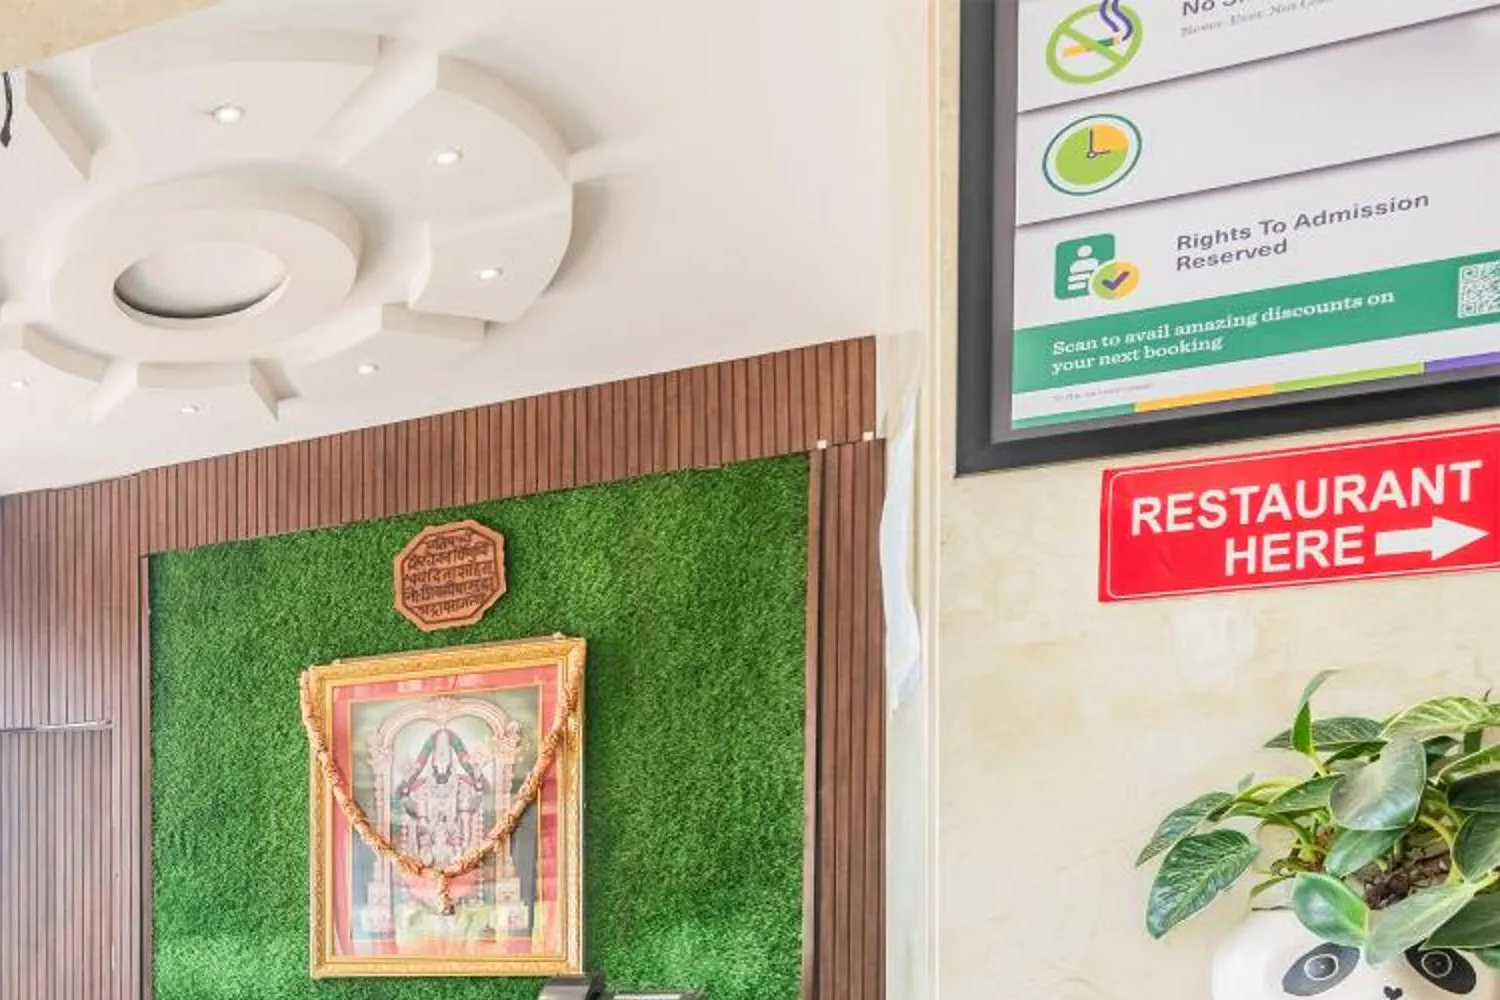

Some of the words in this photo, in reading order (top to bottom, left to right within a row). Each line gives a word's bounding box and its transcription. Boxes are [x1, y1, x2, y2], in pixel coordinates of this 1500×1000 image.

[1177, 227, 1251, 251] Rights
[1258, 219, 1287, 236] To
[1294, 194, 1429, 231] Admission
[1176, 238, 1288, 272] Reserved
[1053, 336, 1098, 355] Scan
[1102, 333, 1121, 347] to
[1124, 323, 1169, 345] avail
[1175, 309, 1258, 337] amazing
[1261, 296, 1363, 323] discounts
[1367, 290, 1395, 305] on
[1051, 357, 1096, 376] your
[1099, 349, 1141, 366] next
[1144, 334, 1224, 361] booking
[1131, 459, 1483, 536] RESTAURANT
[1224, 525, 1365, 577] HERE
